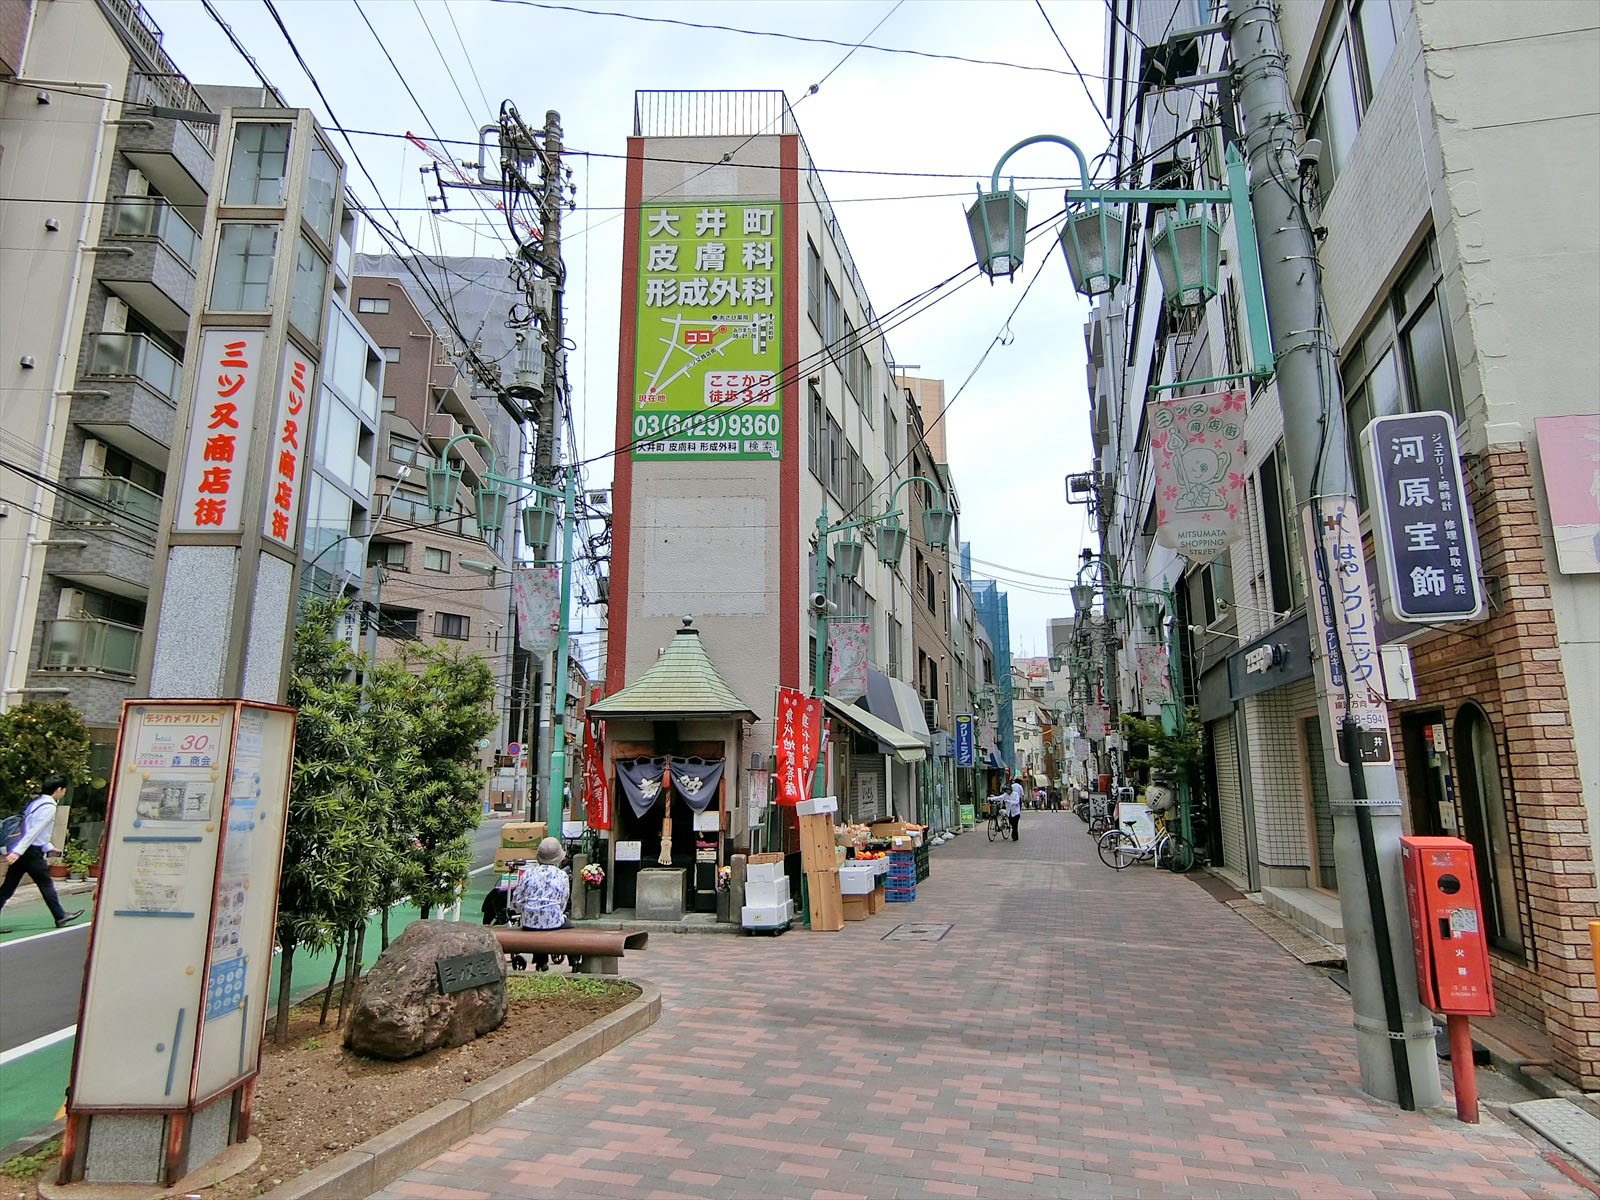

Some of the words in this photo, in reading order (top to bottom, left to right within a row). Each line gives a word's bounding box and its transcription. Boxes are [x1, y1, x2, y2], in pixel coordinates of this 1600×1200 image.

[648, 208, 774, 237] 大井町
[646, 241, 774, 272] 皮膚科
[645, 276, 774, 307] 形成外科
[687, 333, 711, 342] ココ
[710, 375, 771, 387] ここから
[638, 395, 666, 403] 現在地
[709, 390, 771, 403] 徒歩3分
[193, 341, 248, 528] 三ツ又商店街
[634, 414, 780, 437] 03(6429)9360
[271, 361, 308, 542] 三ツ又商店街
[637, 443, 666, 452] 大井町
[669, 443, 696, 451] 皮膚科
[700, 442, 738, 451] 形成外科
[1431, 433, 1453, 512] ジュエリー・腕時計
[1392, 435, 1446, 598] 河原宝飾
[1177, 529, 1228, 539] MITSUMATA
[1180, 538, 1225, 548] SHOPPING
[1444, 519, 1467, 595] 修理・買取・販売
[1333, 543, 1373, 682] はやしクリニック
[145, 714, 218, 723] デジカメプリント
[960, 724, 971, 763] クリーニング
[190, 755, 211, 766] 商会
